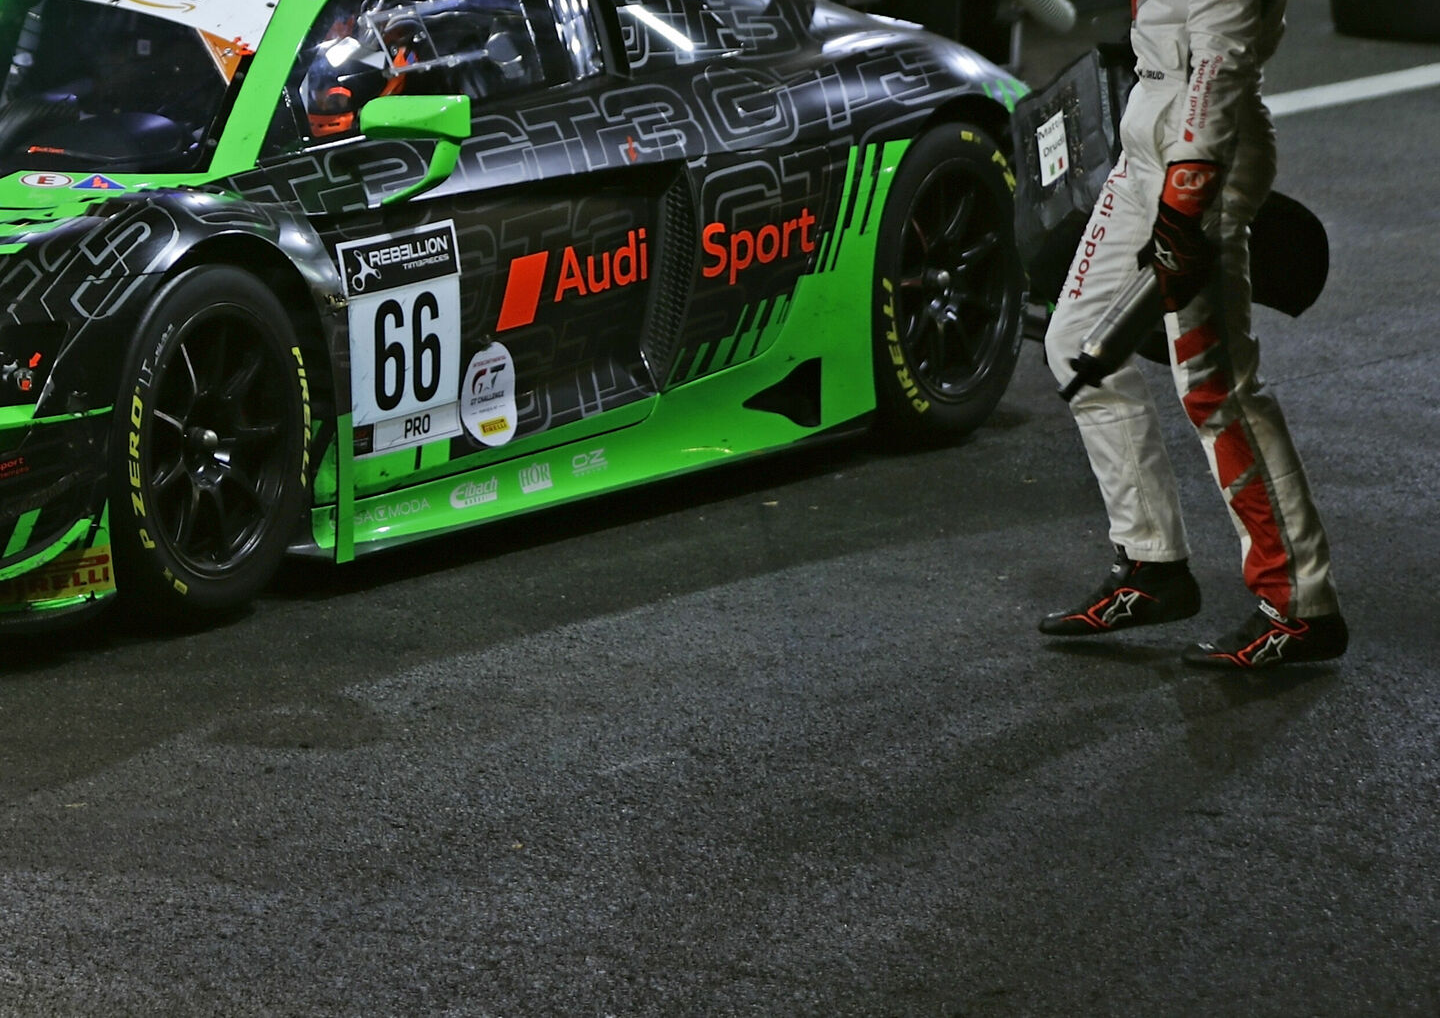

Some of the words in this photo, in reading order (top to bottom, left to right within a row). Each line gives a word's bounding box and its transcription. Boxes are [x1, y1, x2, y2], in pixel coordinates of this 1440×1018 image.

[1185, 95, 1198, 127] Audi
[37, 175, 57, 185] E
[368, 235, 449, 267] REBELLION
[553, 228, 648, 303] Audi
[701, 207, 816, 285] Sport
[1068, 223, 1106, 301] Sport
[374, 290, 442, 411] 66
[882, 277, 931, 414] PIRELLI
[290, 346, 311, 489] PIRELLI
[478, 390, 506, 404] CHALLENGE
[404, 413, 431, 439] PRO
[128, 392, 148, 518] ZERO
[450, 475, 499, 509] Eibach
